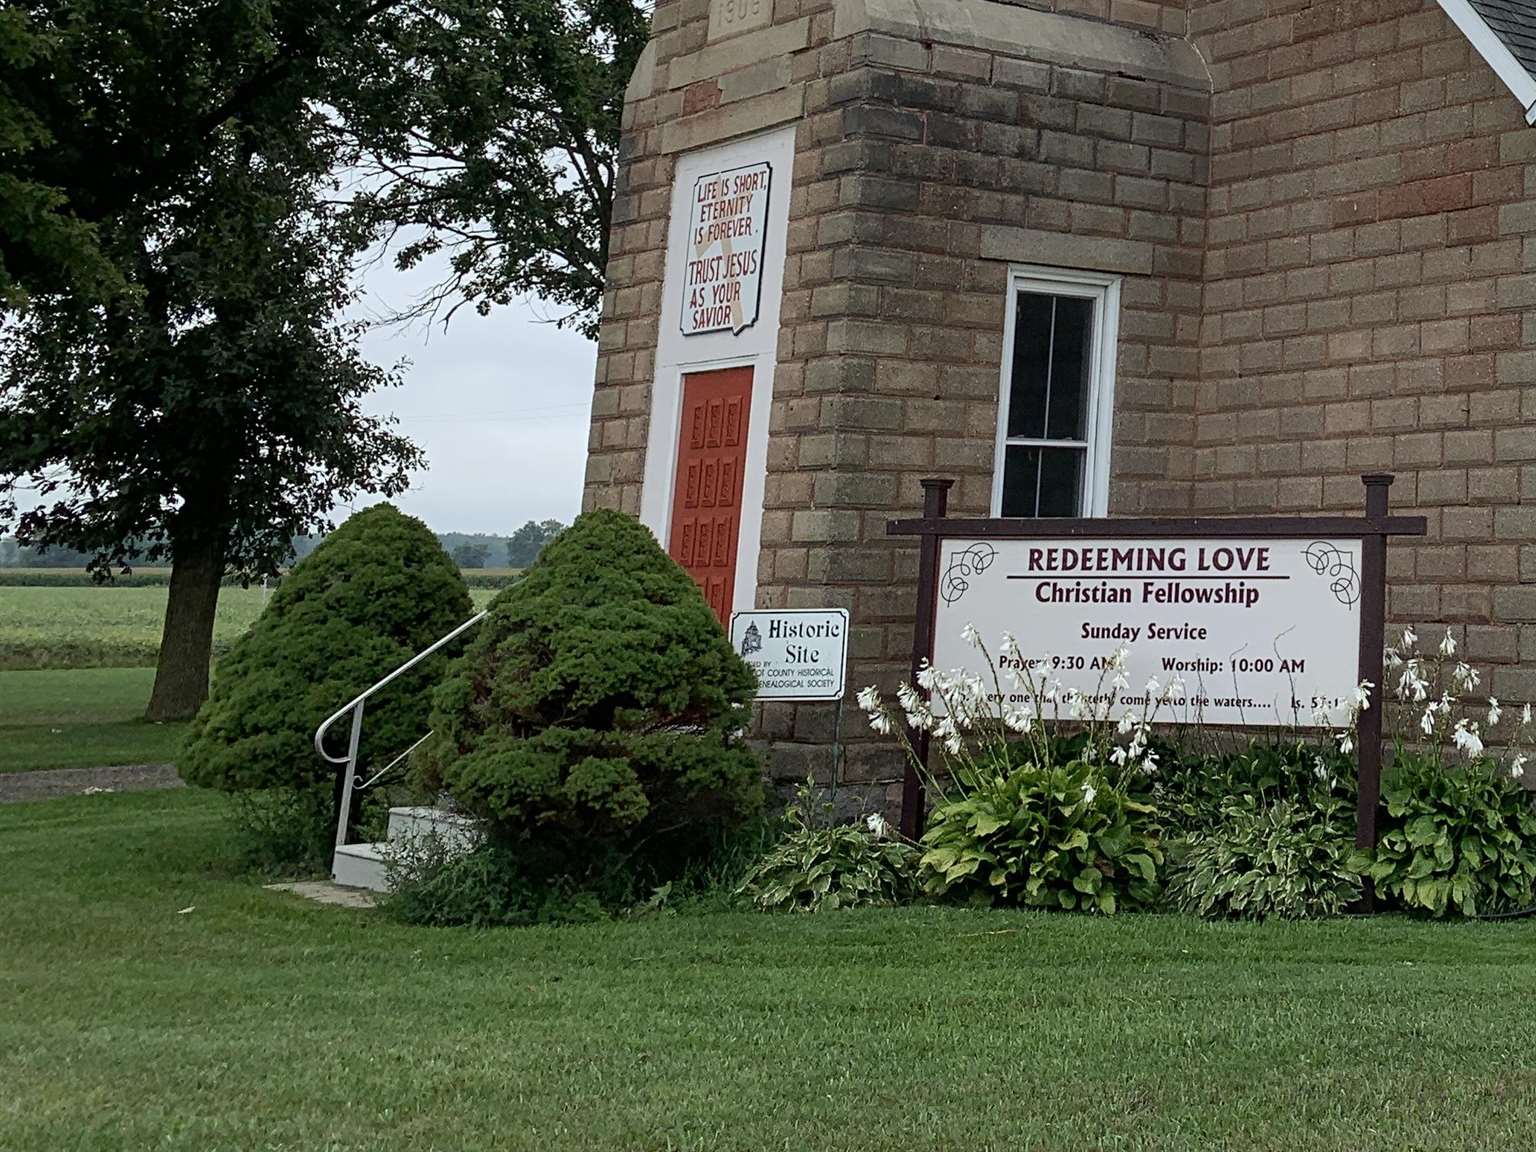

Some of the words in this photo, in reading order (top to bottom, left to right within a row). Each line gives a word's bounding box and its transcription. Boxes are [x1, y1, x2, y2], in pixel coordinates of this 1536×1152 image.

[697, 181, 719, 202] LIFE
[721, 177, 730, 197] IS
[733, 170, 767, 196] SHORT,
[700, 194, 754, 223] ETERNITY
[694, 226, 703, 245] IS
[688, 255, 723, 286] TRUST
[723, 249, 758, 280] JESUS
[689, 287, 705, 309] AS
[712, 281, 742, 304] YOUR
[692, 305, 732, 330] SAVIOR
[1028, 547, 1187, 572] REDEEMING
[1198, 547, 1271, 572] LOVE
[1035, 581, 1132, 604] Christian
[1142, 581, 1260, 608] Fellowship
[768, 619, 840, 639] Historic
[1081, 622, 1141, 642] Sunday
[1147, 622, 1208, 640] Service
[785, 644, 820, 664] Site
[1052, 656, 1085, 669] 9:30
[767, 668, 795, 677] COUNTY
[797, 667, 834, 677] HISTORICAL
[1161, 657, 1224, 674] Worship:
[1231, 658, 1274, 672] 10:00
[1279, 659, 1306, 673] AM
[759, 679, 803, 688] ENEALOGICAL
[807, 679, 835, 688] SOCIETY
[1009, 693, 1030, 703] one
[1120, 696, 1151, 705] come
[1190, 695, 1209, 706] the
